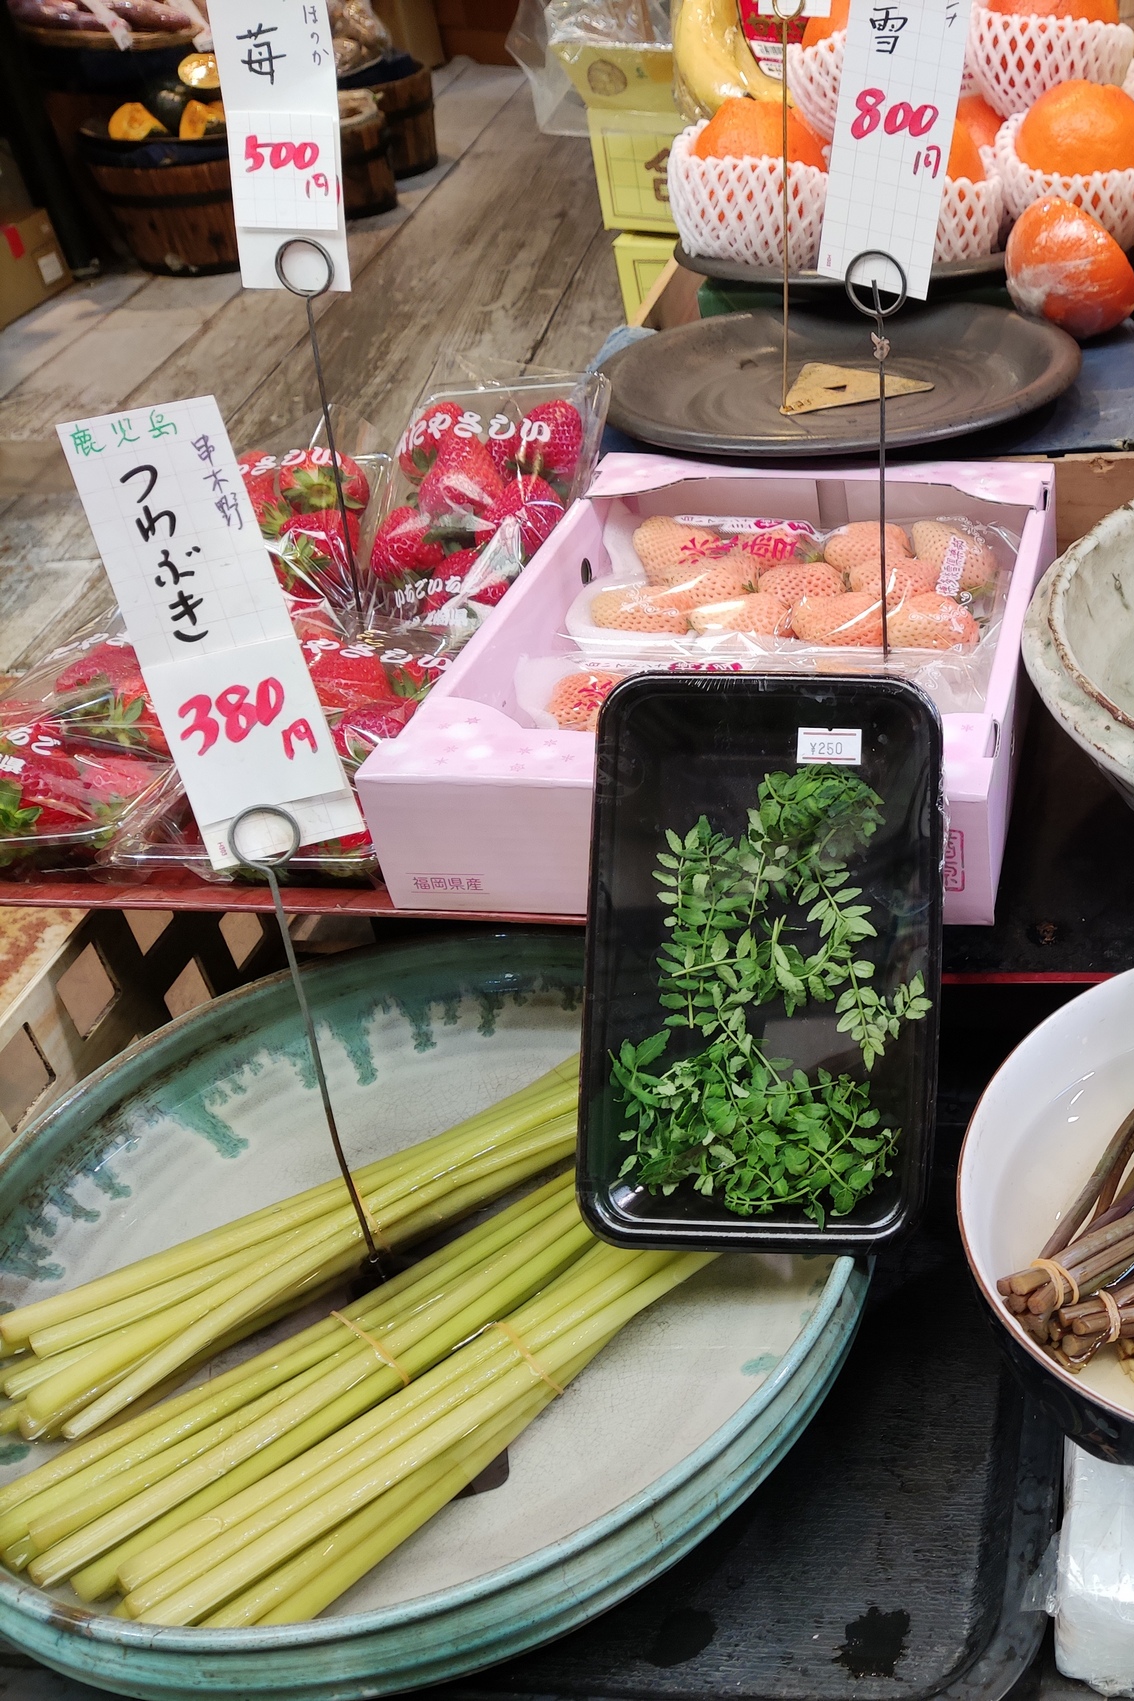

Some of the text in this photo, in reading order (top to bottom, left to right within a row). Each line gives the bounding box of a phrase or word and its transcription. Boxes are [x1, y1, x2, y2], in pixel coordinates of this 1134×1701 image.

[236, 23, 287, 85] 苺
[870, 7, 908, 54] 雪
[850, 88, 939, 139] 800
[244, 134, 320, 172] 500
[70, 409, 178, 457] 鹿児島
[120, 464, 209, 643] つわぶき
[178, 677, 319, 760] 380 円
[810, 741, 843, 756] ¥250
[413, 876, 484, 891] 福岡県産
